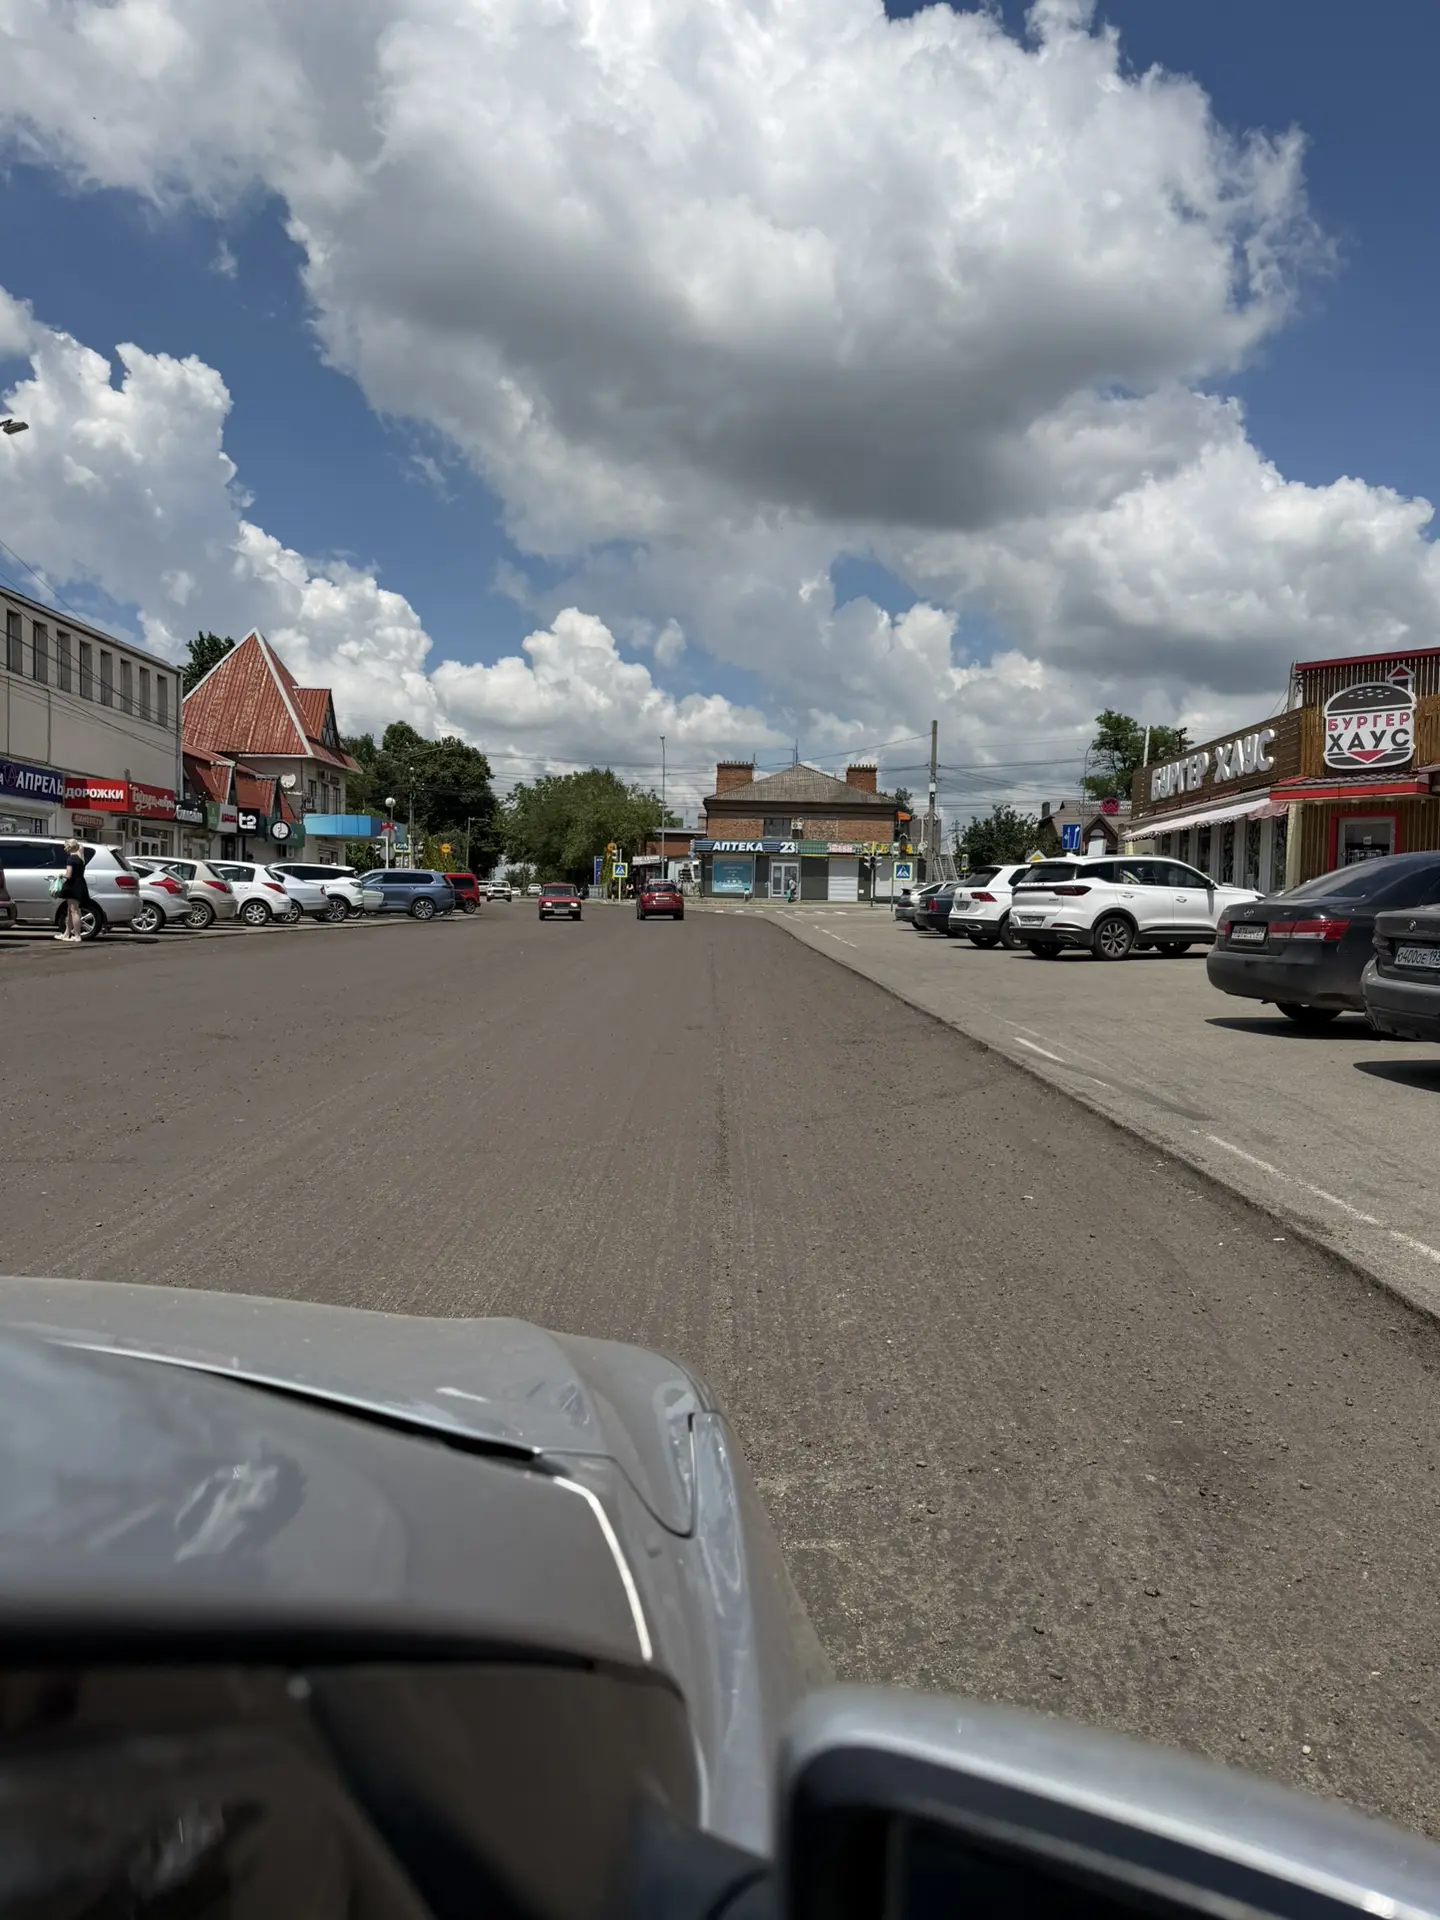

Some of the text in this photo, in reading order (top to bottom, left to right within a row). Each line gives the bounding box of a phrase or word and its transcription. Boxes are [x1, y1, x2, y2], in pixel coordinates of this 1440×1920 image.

[1327, 711, 1411, 732] БУРГЕР
[1326, 728, 1410, 753] ХАУС
[1150, 728, 1276, 802] БУРГЕР ХАУС
[15, 770, 64, 796] АПРЕЛЬ
[65, 786, 125, 800] ДОРОЖКИ
[712, 841, 764, 852] АПТЕКА
[779, 841, 796, 854] 23
